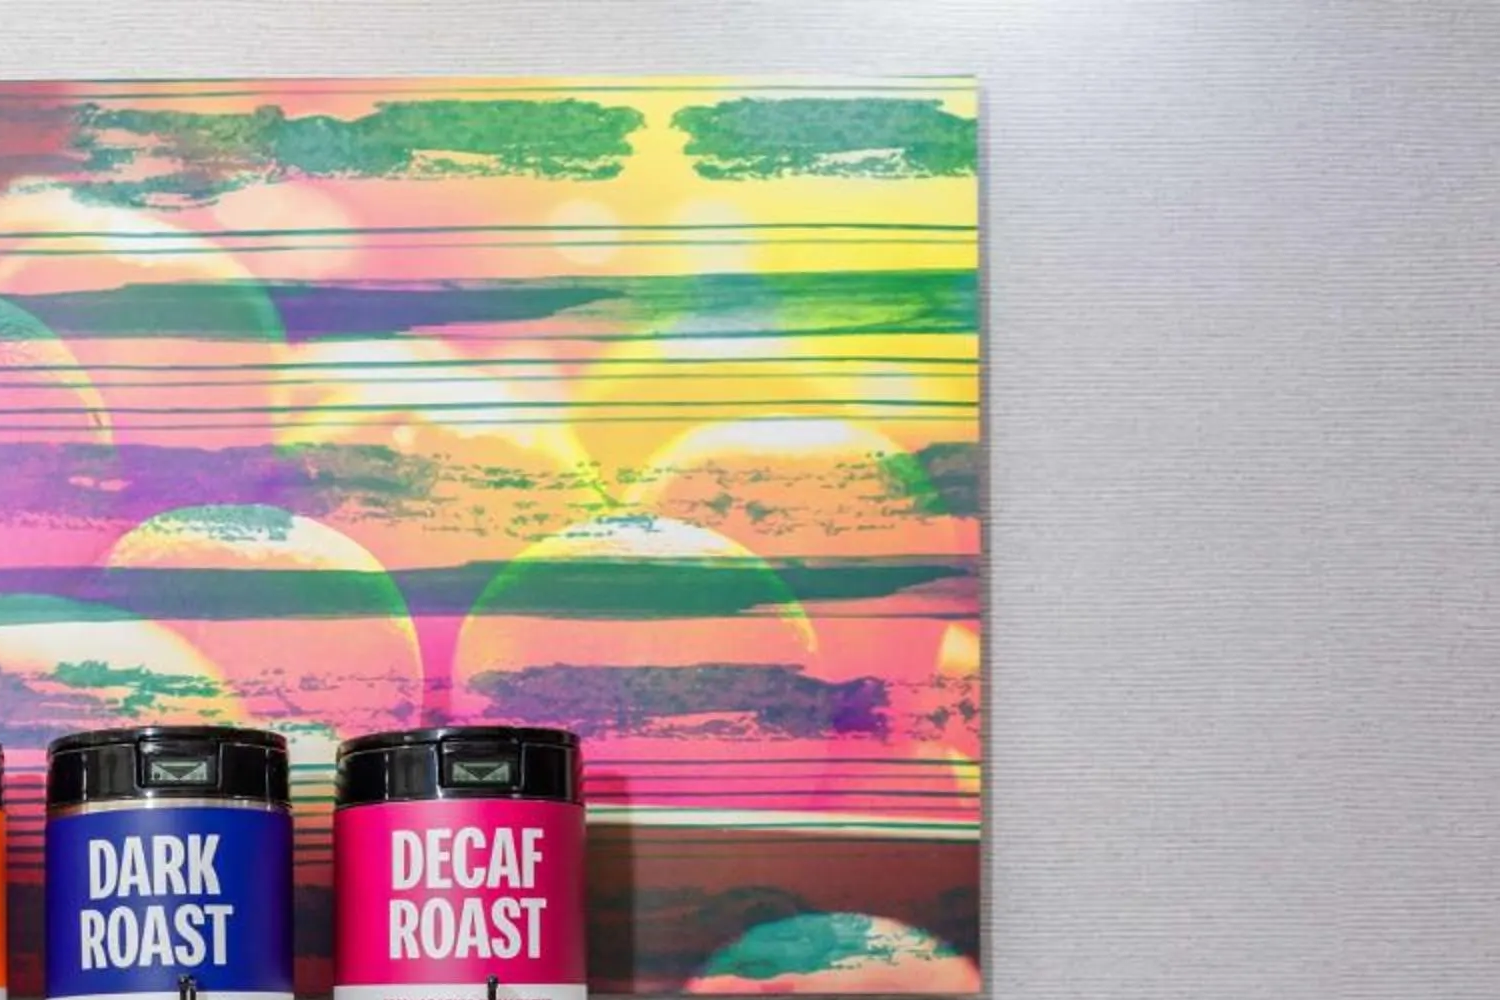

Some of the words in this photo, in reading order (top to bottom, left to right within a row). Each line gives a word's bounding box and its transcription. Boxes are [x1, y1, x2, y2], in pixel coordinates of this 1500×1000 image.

[88, 834, 221, 899] DARK
[390, 828, 543, 890] DECAF
[80, 904, 233, 969] ROAST
[388, 897, 547, 959] ROAST
